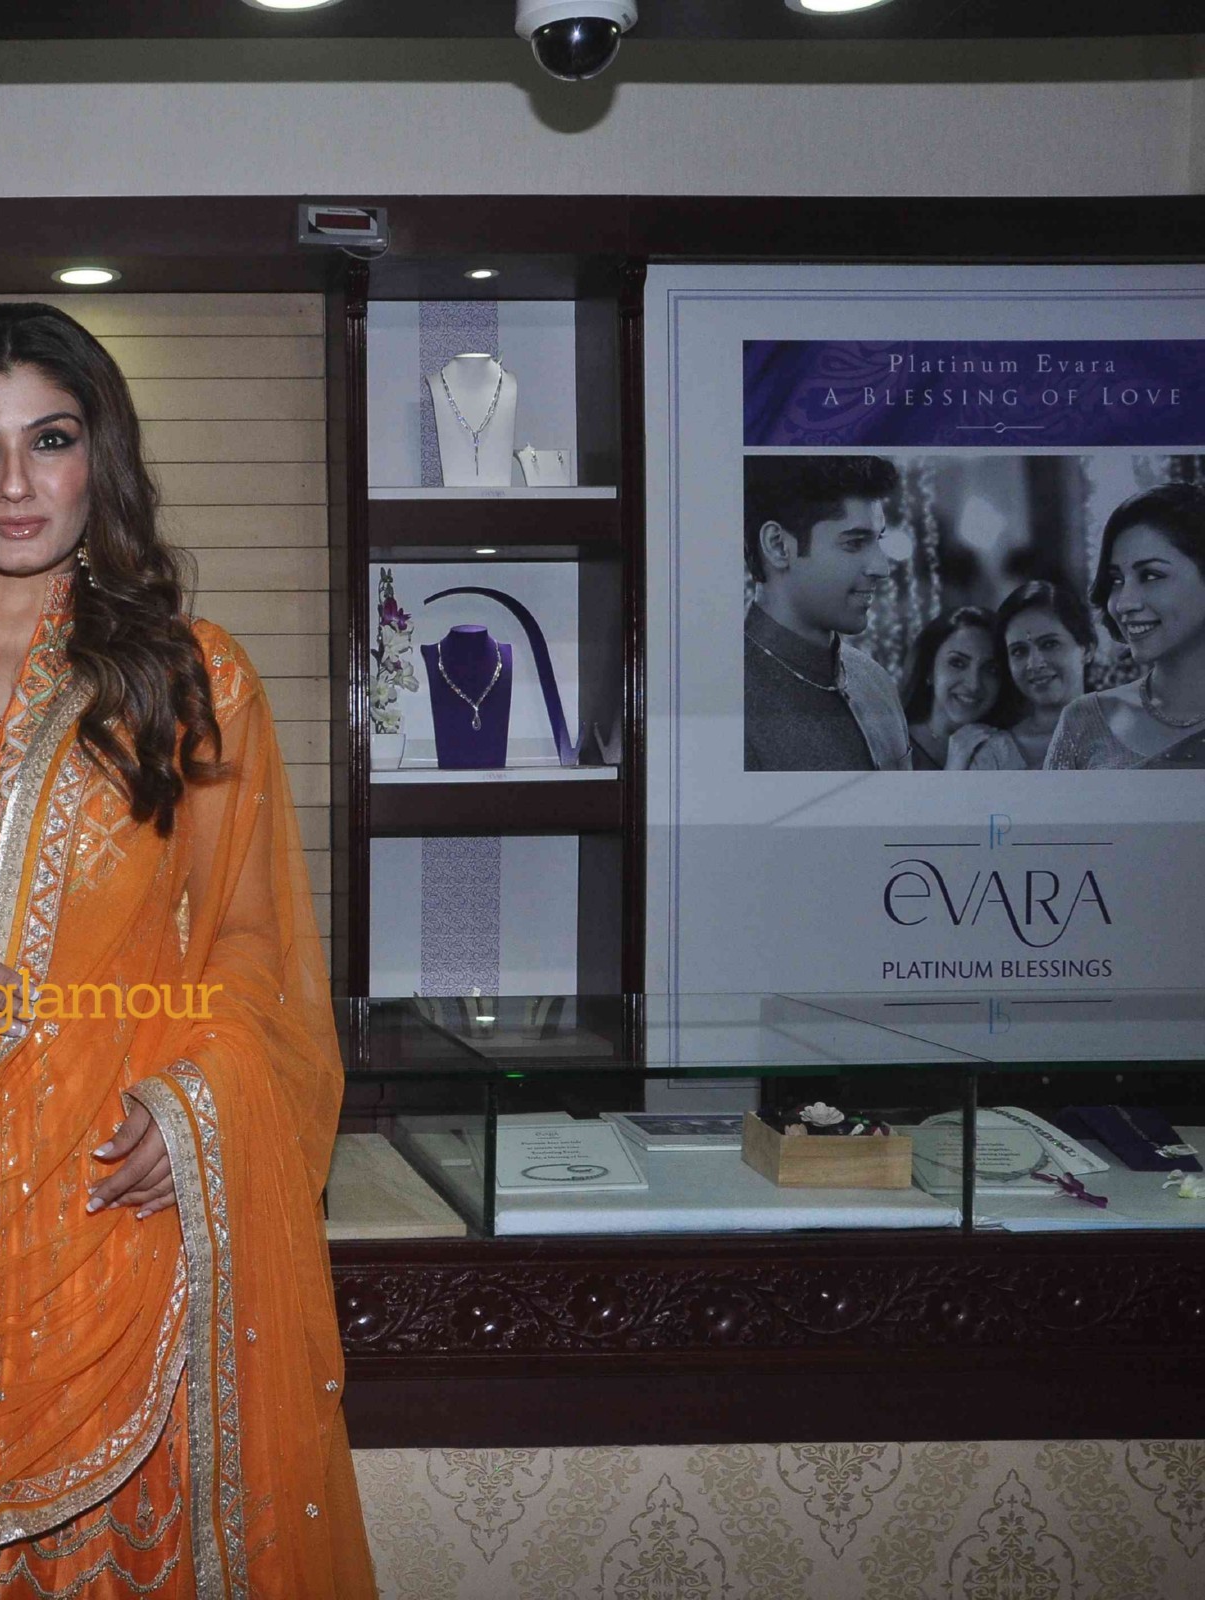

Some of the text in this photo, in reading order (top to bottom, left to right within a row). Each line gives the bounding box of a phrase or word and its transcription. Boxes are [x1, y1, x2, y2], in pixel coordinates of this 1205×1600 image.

[888, 353, 1116, 374] Platinum Evara
[823, 387, 1181, 406] A BLESSING OF LOVE
[882, 958, 1113, 979] PLATINUM BLESSINGS
